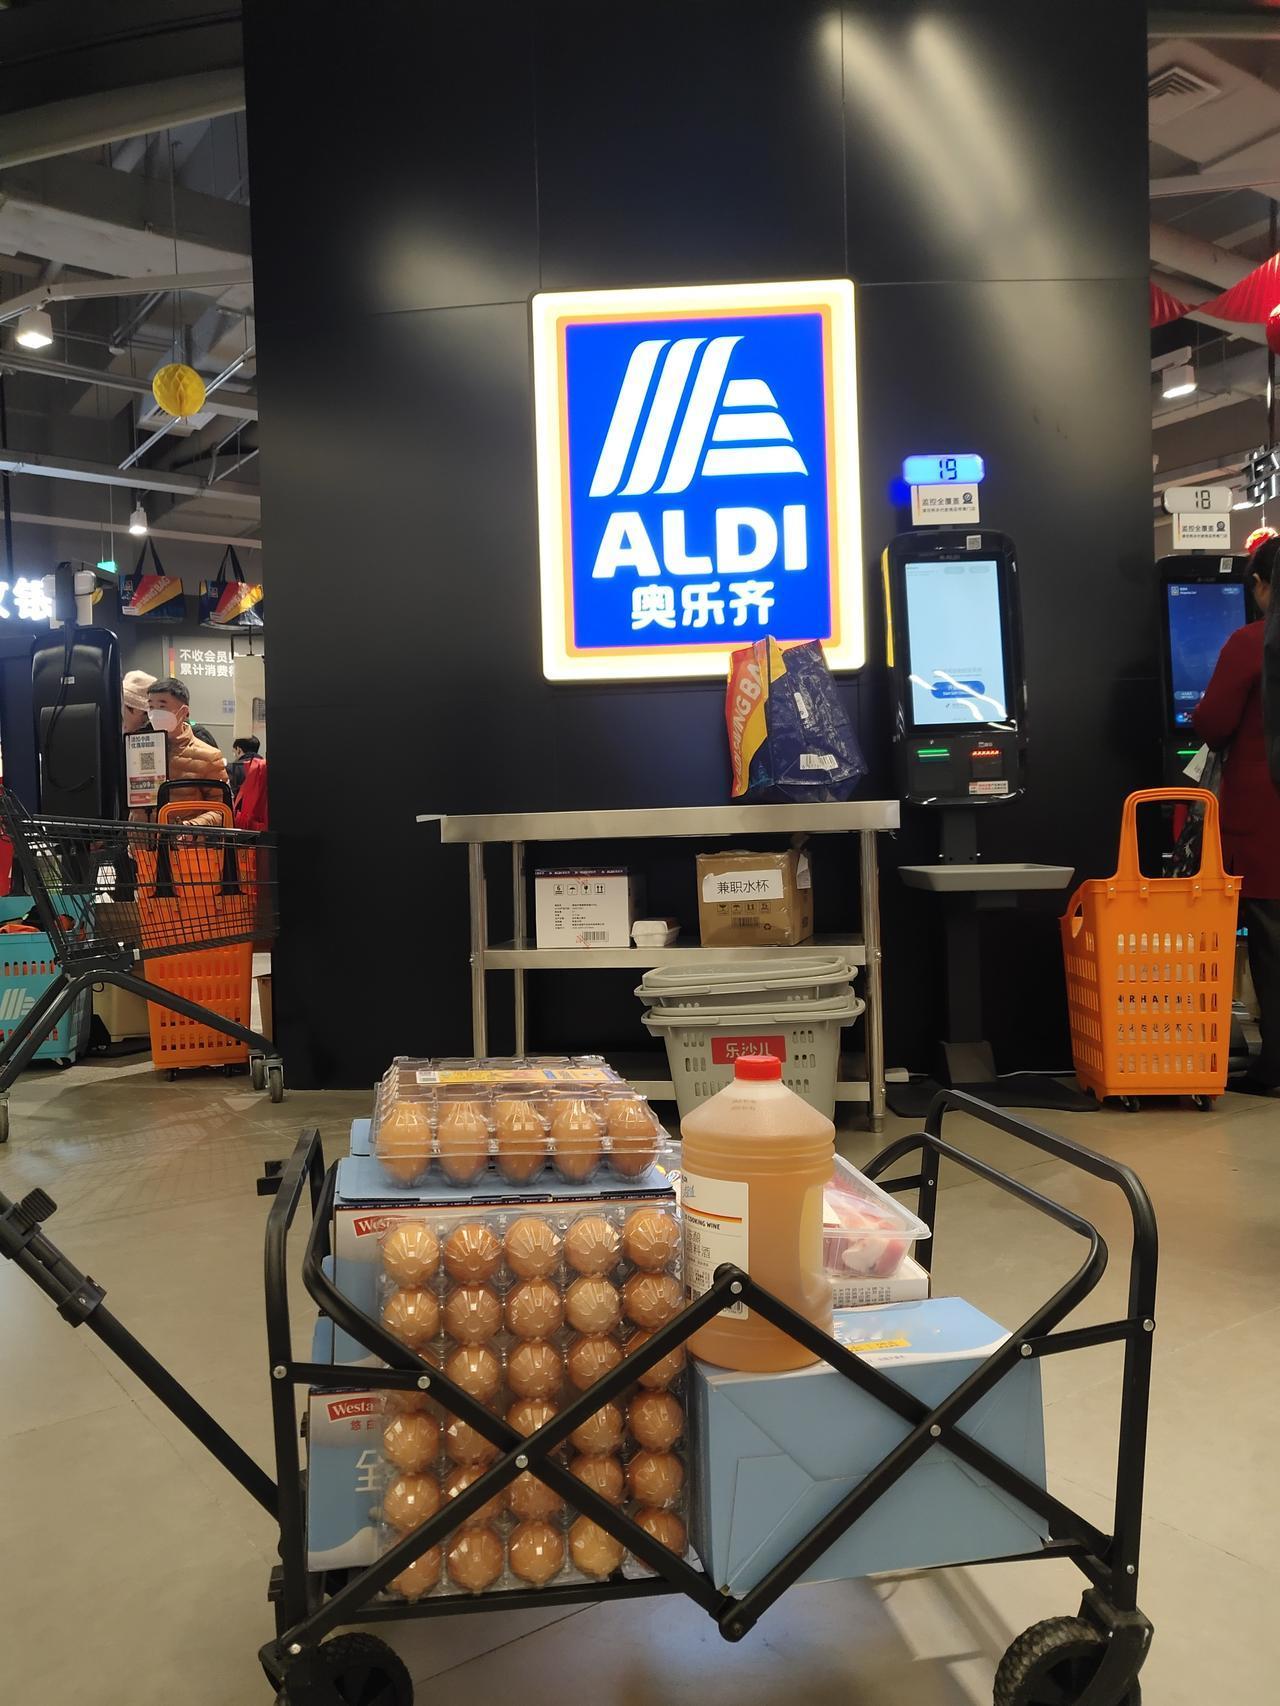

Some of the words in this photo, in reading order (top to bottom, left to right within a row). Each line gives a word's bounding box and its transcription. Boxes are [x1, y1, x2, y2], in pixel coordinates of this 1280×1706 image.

[938, 458, 957, 480] 19
[1195, 490, 1211, 510] 18
[592, 504, 808, 579] ALDI
[631, 580, 775, 630] 奥乐齐
[717, 879, 770, 895] 兼职水杯
[726, 1042, 772, 1058] 乐沙儿
[706, 1222, 720, 1230] WINE
[333, 1401, 374, 1416] Westa
